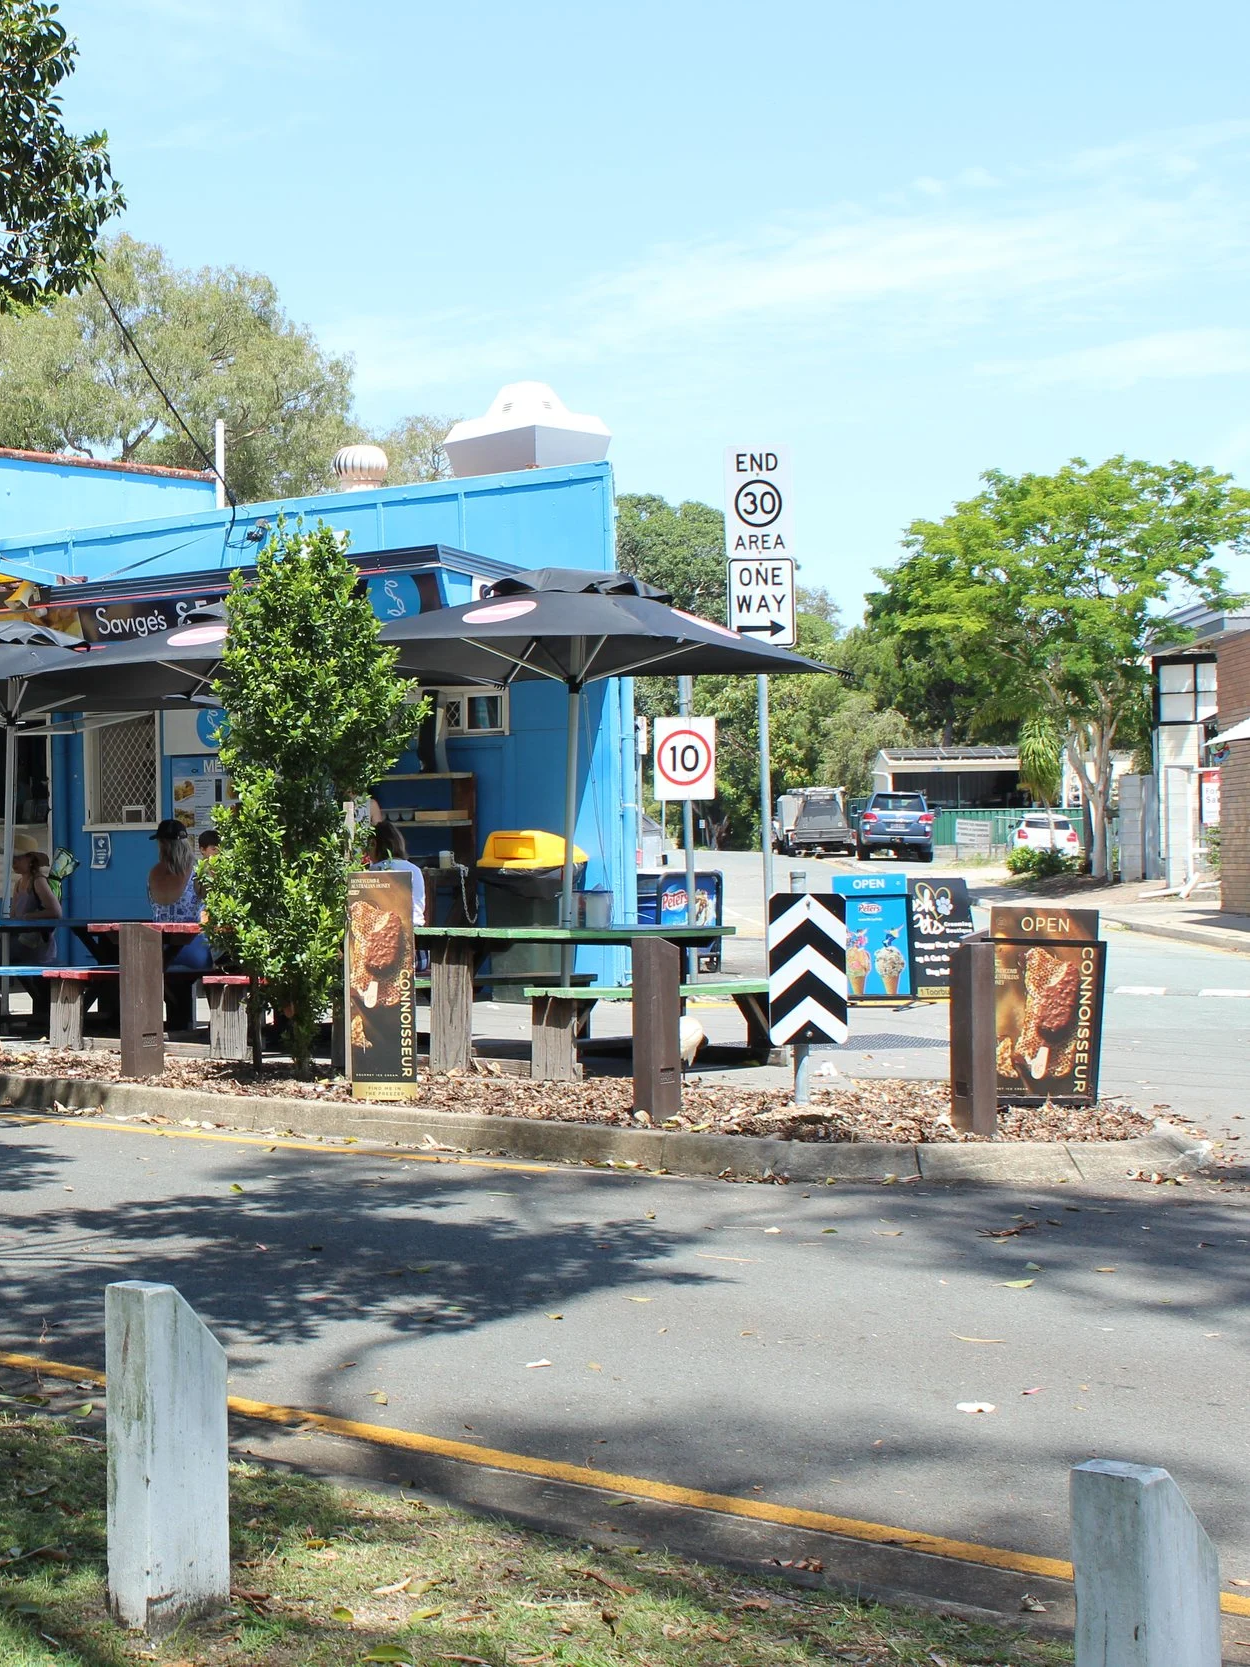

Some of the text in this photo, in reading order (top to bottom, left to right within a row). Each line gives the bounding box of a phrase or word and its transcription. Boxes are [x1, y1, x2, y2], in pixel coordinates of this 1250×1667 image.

[736, 453, 778, 472] END
[743, 491, 776, 515] 30
[735, 534, 785, 550] AREA
[740, 567, 783, 586] ONE
[737, 594, 786, 613] WAY
[96, 607, 167, 637] Savige's
[203, 759, 225, 773] ME
[670, 745, 699, 772] 10
[853, 879, 885, 889] OPEN
[858, 903, 881, 914] Peters
[1021, 916, 1070, 932] OPEN
[926, 988, 950, 996] Toorbu
[400, 969, 412, 1077] CONNOISSEUR
[1073, 947, 1094, 1092] CONNOISSEUR
